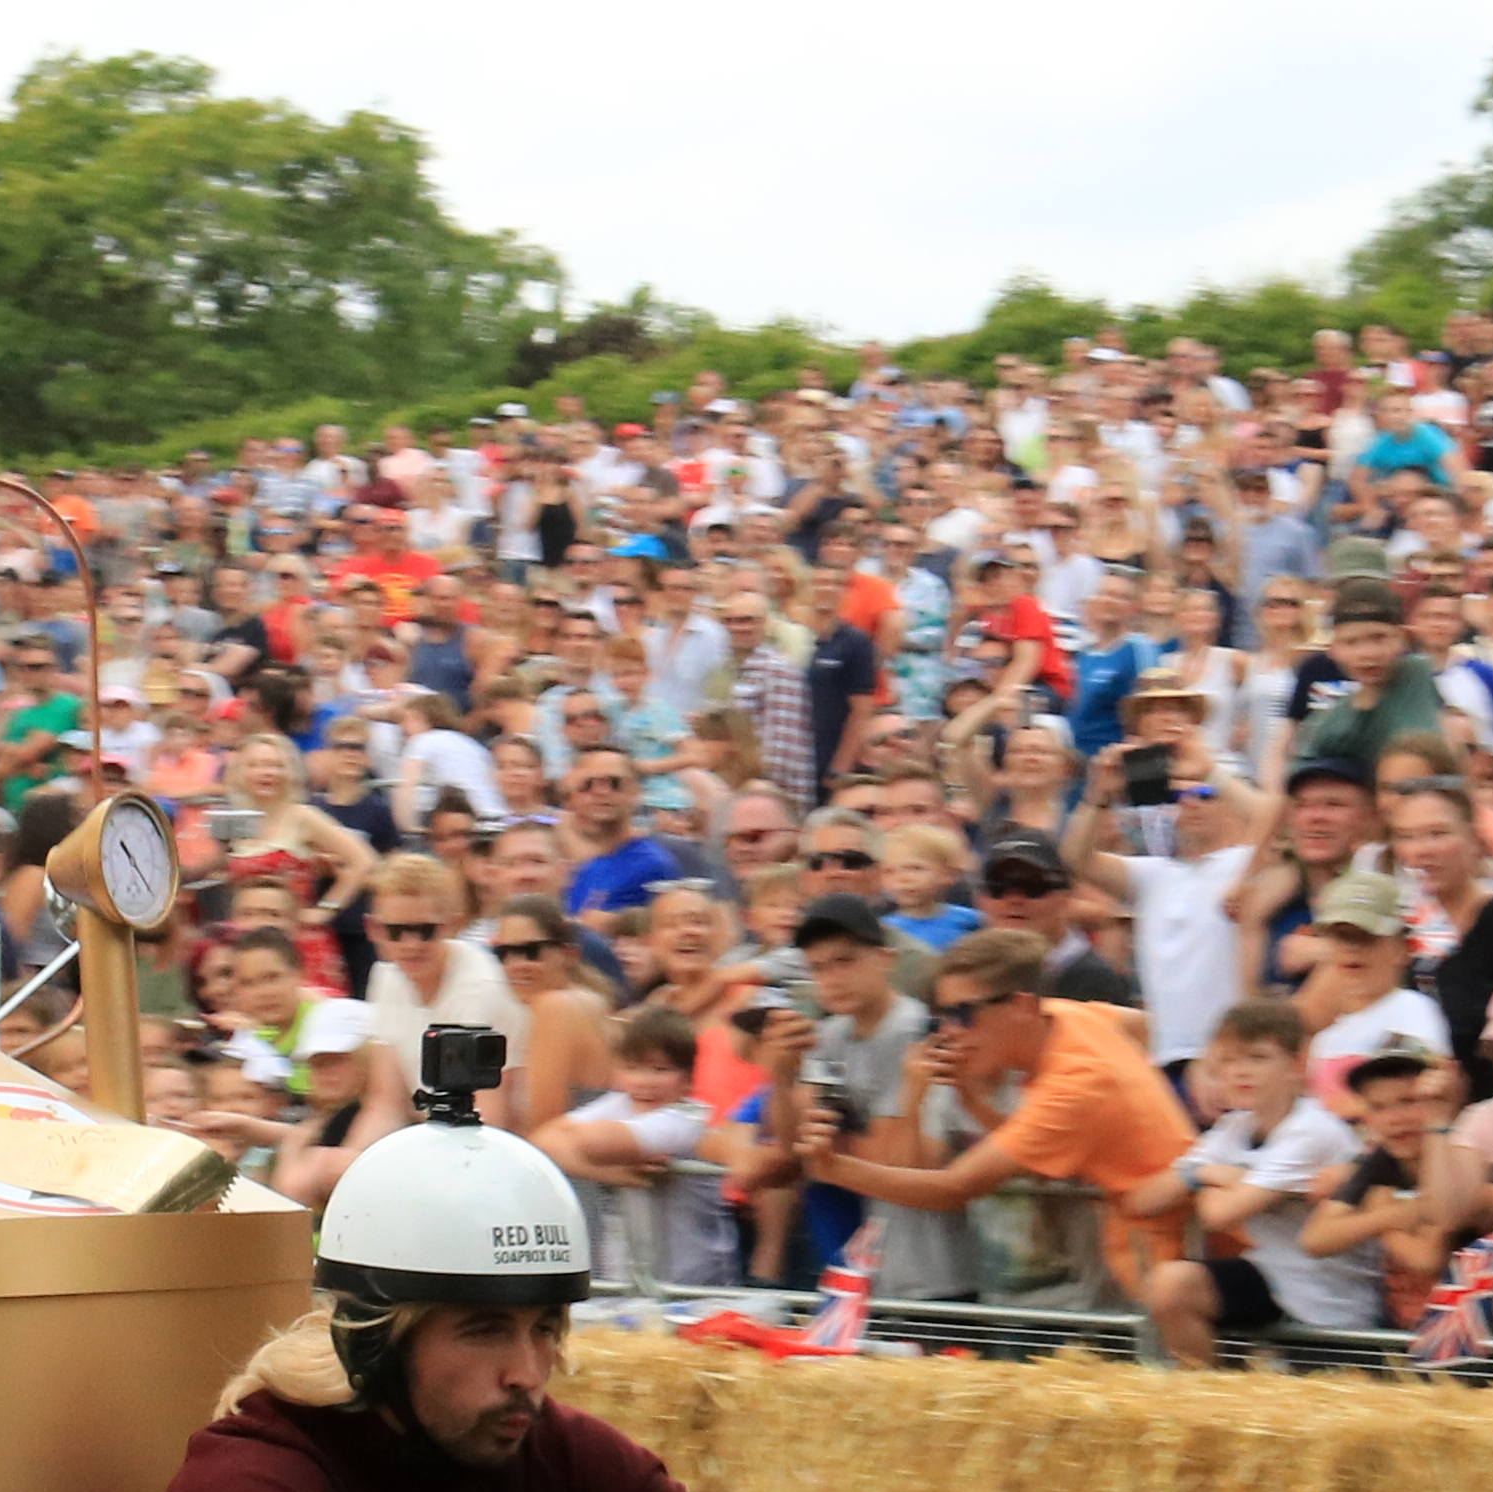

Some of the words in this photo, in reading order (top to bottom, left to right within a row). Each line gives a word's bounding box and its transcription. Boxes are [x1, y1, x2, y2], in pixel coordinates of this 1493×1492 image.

[492, 1225, 528, 1247] RED
[535, 1224, 569, 1246] BULL
[494, 1250, 547, 1265] SOAPBOX
[550, 1249, 570, 1263] RACE
